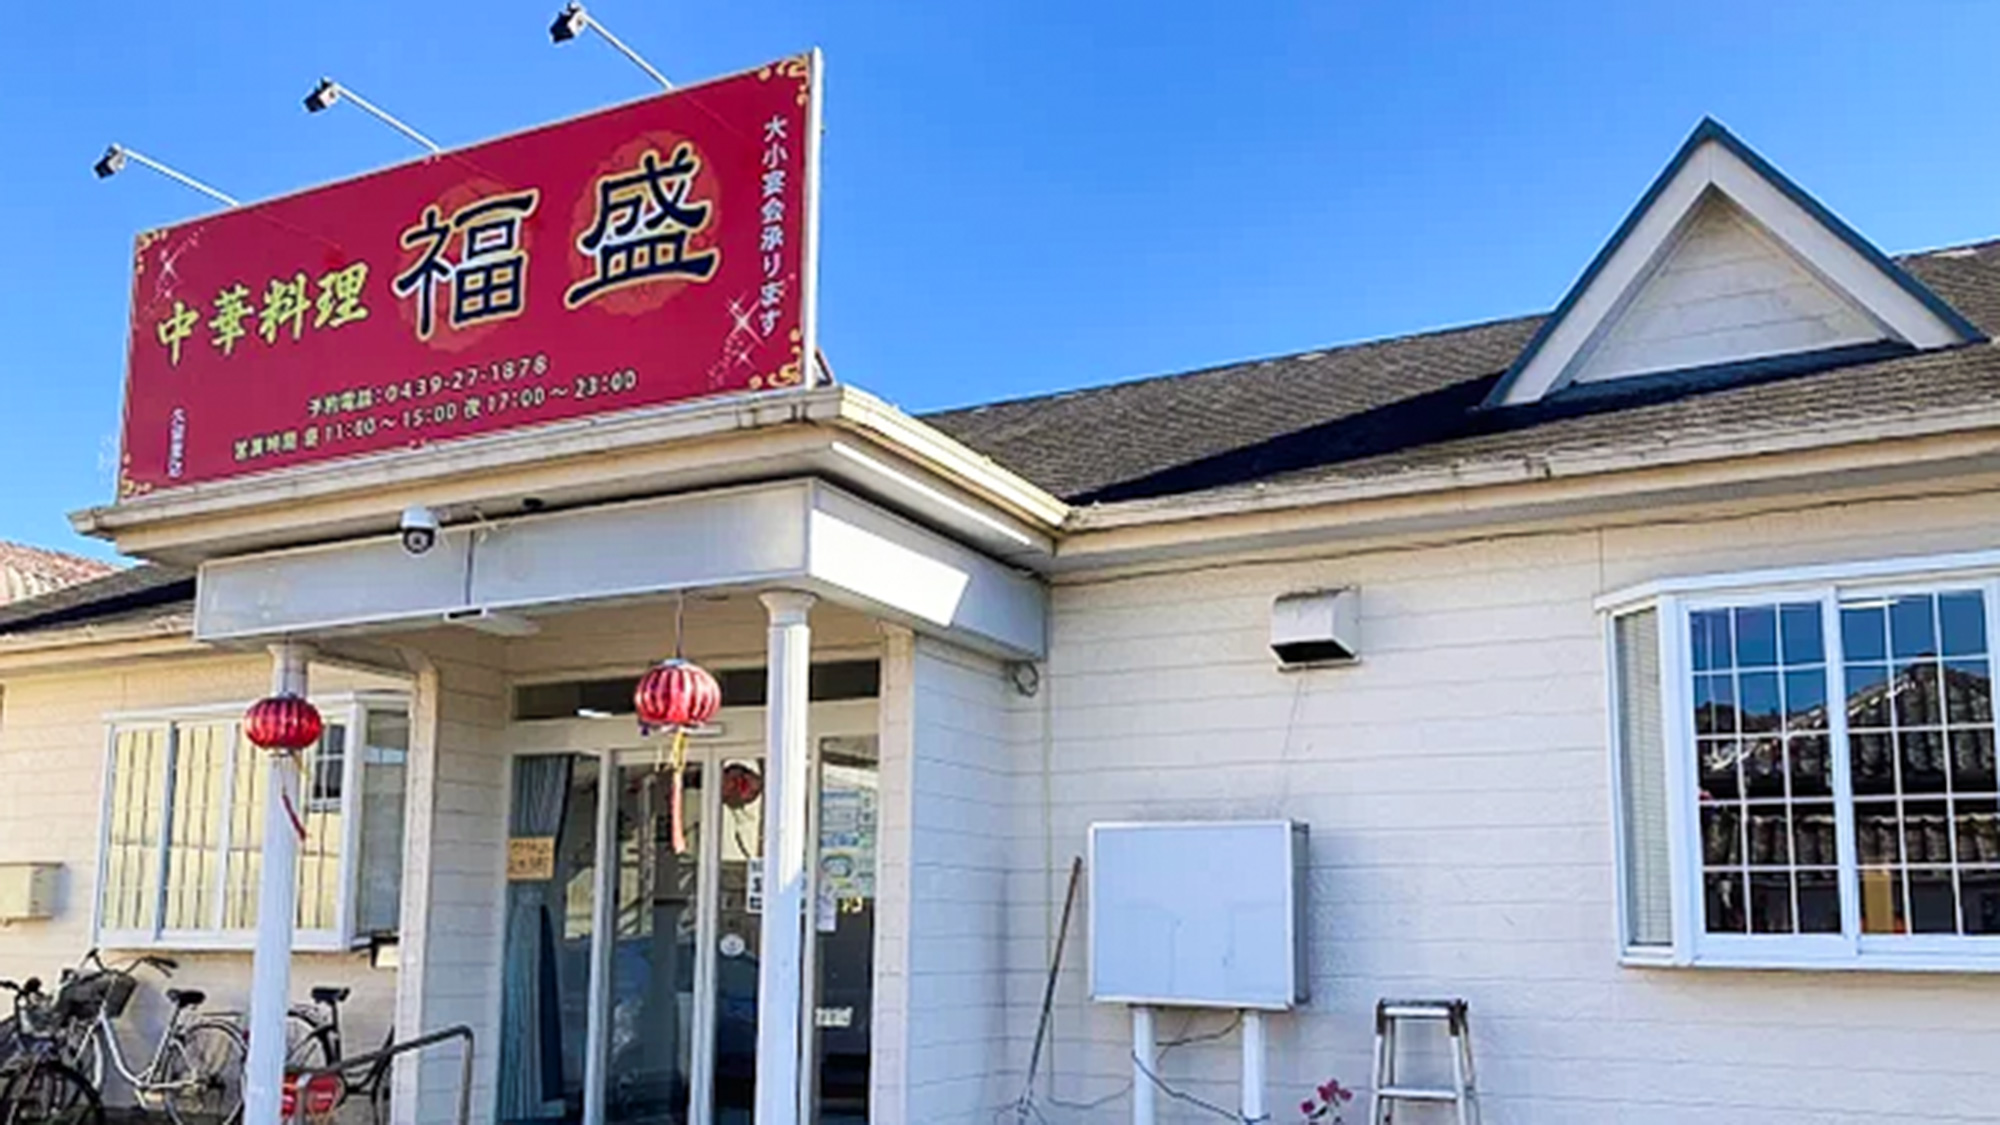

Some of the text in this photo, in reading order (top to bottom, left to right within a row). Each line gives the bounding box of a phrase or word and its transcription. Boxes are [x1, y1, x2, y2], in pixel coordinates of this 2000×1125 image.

[157, 261, 369, 368] 中華料理
[392, 141, 720, 341] 福盛
[759, 114, 788, 337] 大小宴会承ります
